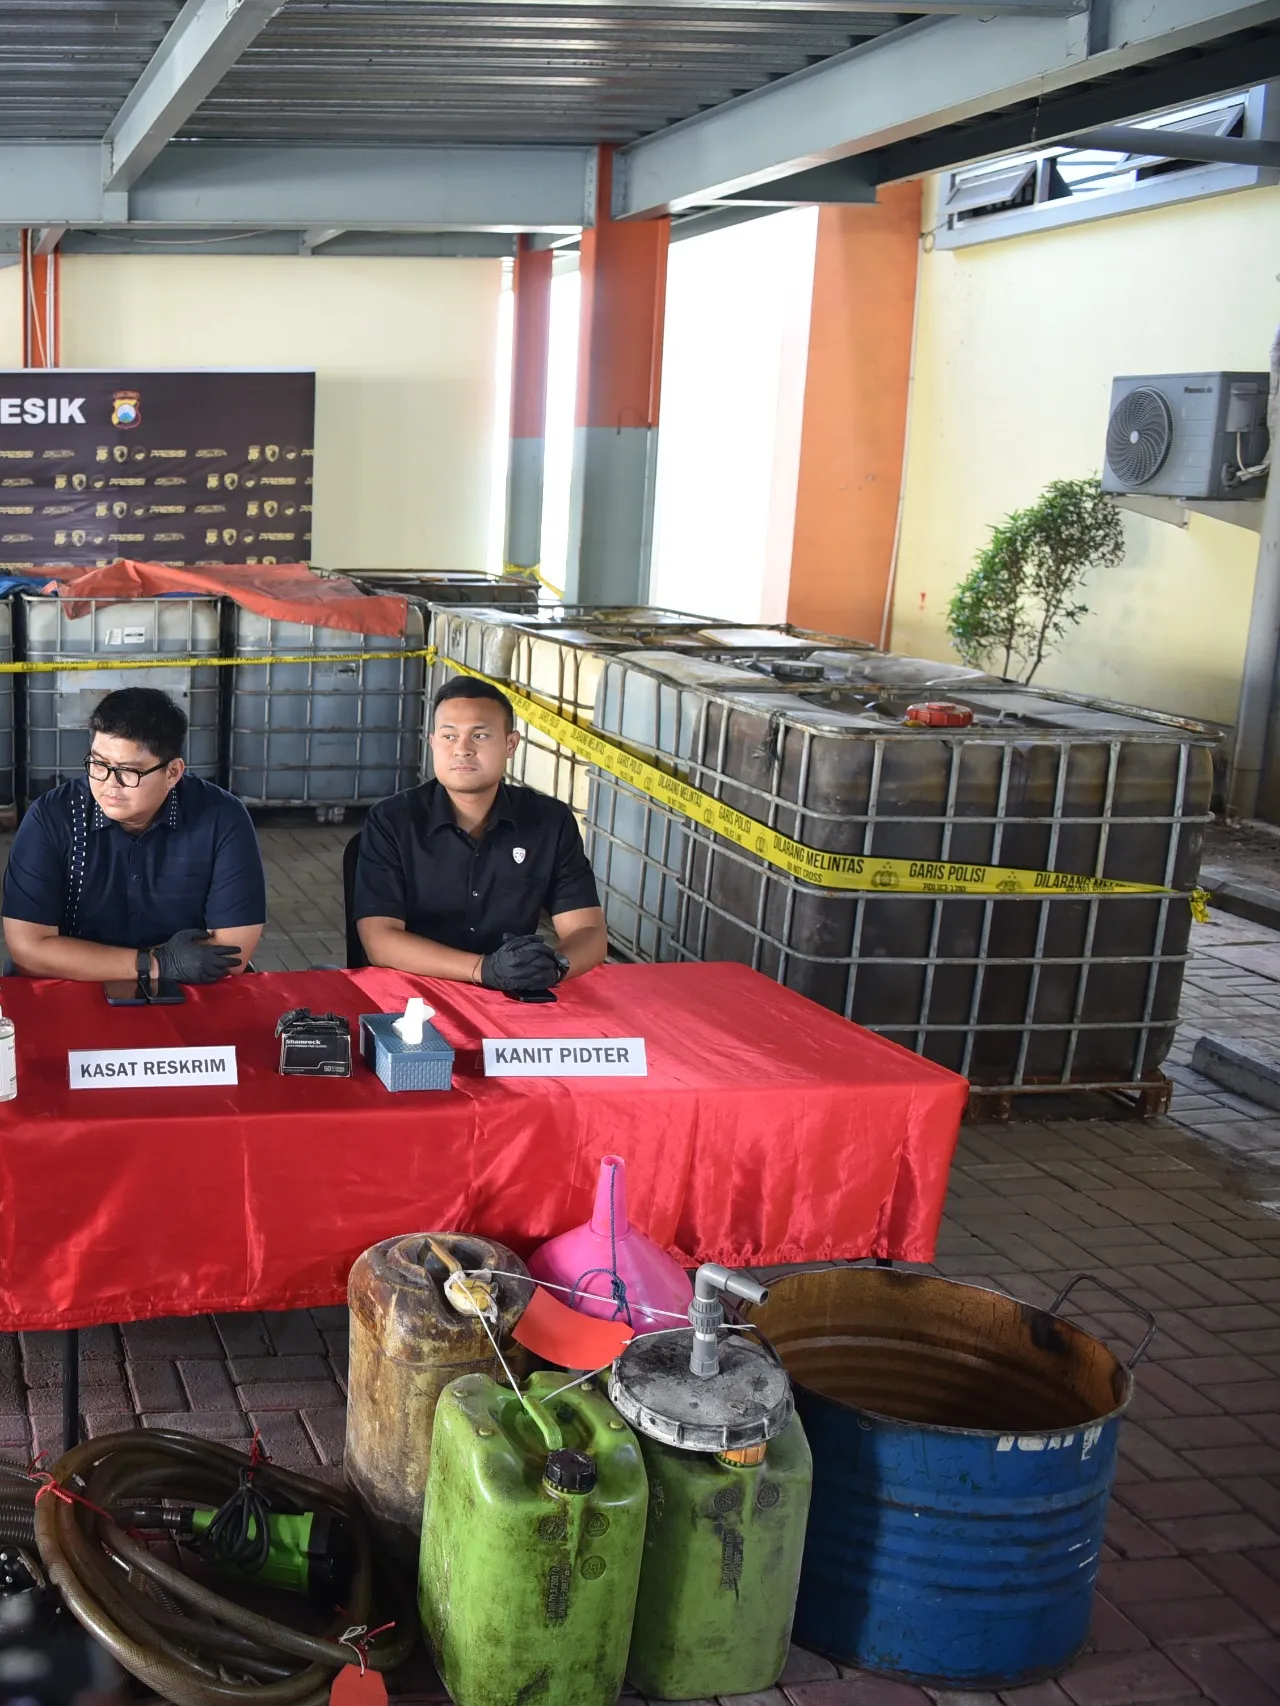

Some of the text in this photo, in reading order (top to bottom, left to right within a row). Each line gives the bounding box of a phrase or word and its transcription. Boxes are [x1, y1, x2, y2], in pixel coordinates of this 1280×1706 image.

[617, 752, 643, 775] GARIS POLISI
[658, 774, 702, 808] DILARANG MELINTAS
[718, 806, 752, 834] GARIS POLISI
[773, 835, 864, 874] DILARANG MELINTAS
[787, 861, 823, 883] DO NOT CROSS
[909, 863, 986, 883] GARIS POLISI
[1034, 873, 1091, 888] DILARANG
[495, 1047, 629, 1064] KANIT PIDTER
[81, 1058, 225, 1078] KASAT RESKRIM
